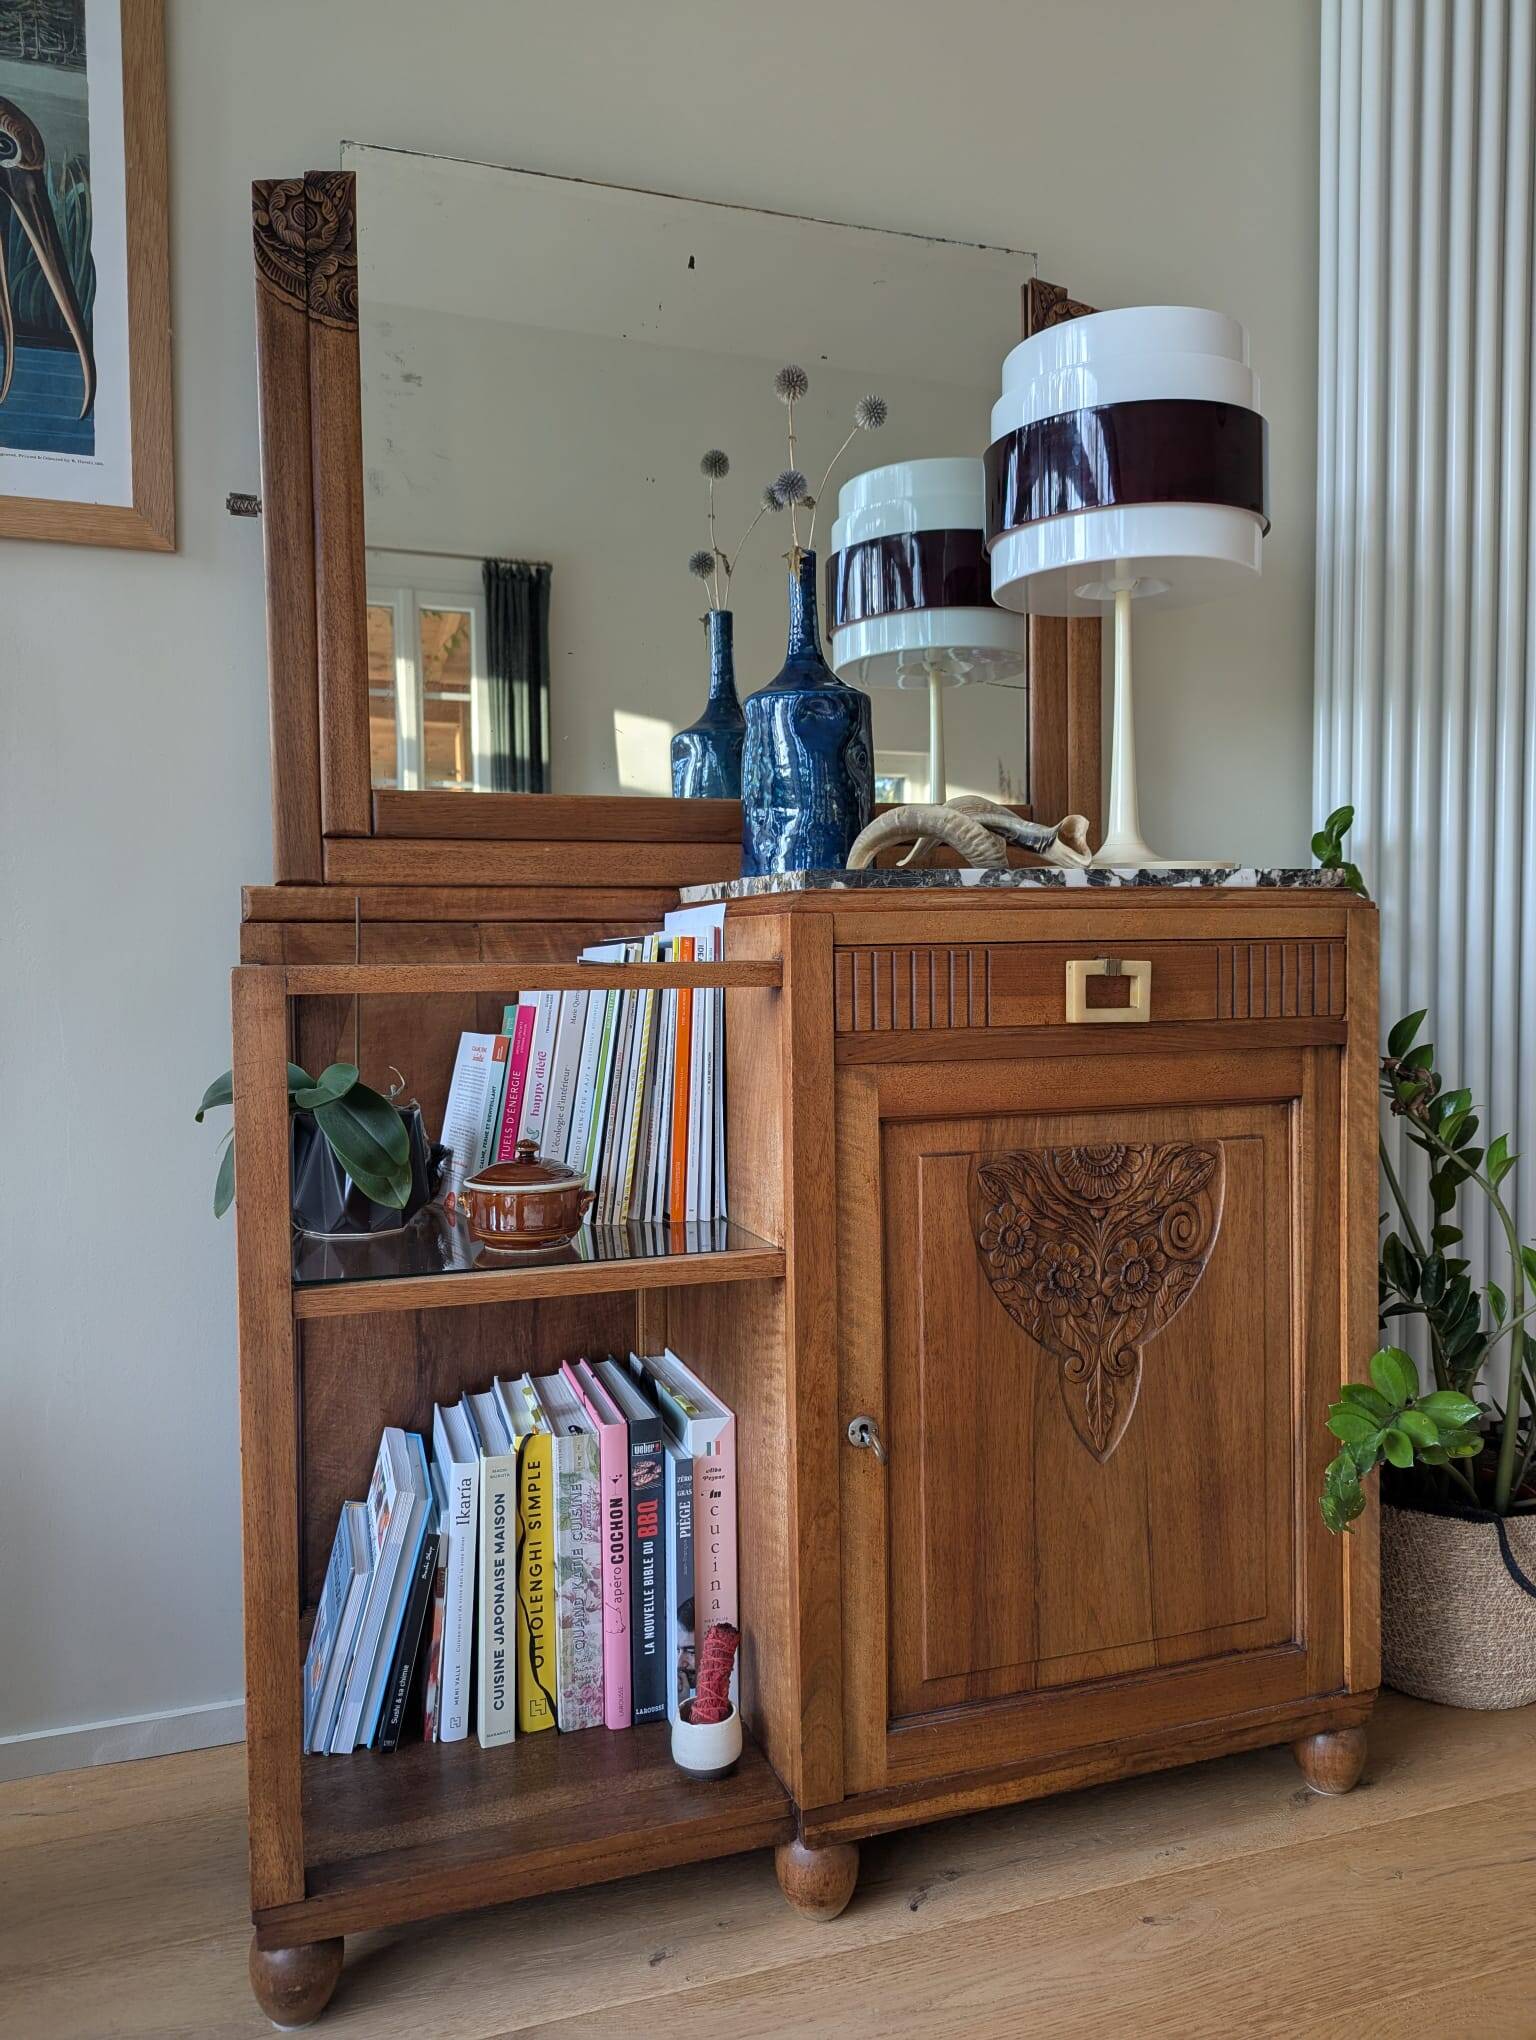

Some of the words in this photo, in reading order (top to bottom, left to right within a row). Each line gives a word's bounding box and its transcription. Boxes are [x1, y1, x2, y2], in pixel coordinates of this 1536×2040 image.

[506, 1070, 521, 1124] D'ÉNERGIE
[530, 1081, 545, 1117] happy
[556, 1065, 570, 1111] d'intérieur
[551, 1110, 566, 1154] L'écologie
[578, 1095, 586, 1134] BIEN-ÊTRE
[482, 1130, 490, 1149] FERME
[501, 1127, 513, 1161] TUELS
[456, 1478, 472, 1526] Ikaría
[528, 1460, 542, 1529] SIMPLE
[570, 1483, 584, 1542] CUISINE
[677, 1489, 693, 1497] GRAS
[493, 1493, 506, 1554] MAISON
[610, 1497, 624, 1566] COCHON
[636, 1498, 659, 1539] BBQ
[677, 1501, 691, 1538] PIÈGE
[643, 1542, 654, 1554] DU
[572, 1548, 584, 1590] KATIE
[610, 1567, 624, 1604] apéro
[643, 1558, 655, 1588] BIBLE
[493, 1559, 505, 1645] JAPONAISE
[528, 1540, 544, 1668] OTTOLENGHI
[644, 1588, 655, 1639] NOUVELLE
[574, 1596, 586, 1651] QUAND
[644, 1642, 655, 1655] LA
[398, 1688, 405, 1697] sa
[399, 1664, 410, 1688] chimie
[493, 1649, 505, 1711] CUISINE
[390, 1704, 401, 1724] Sushi
[636, 1704, 665, 1716] LAROUSSE
